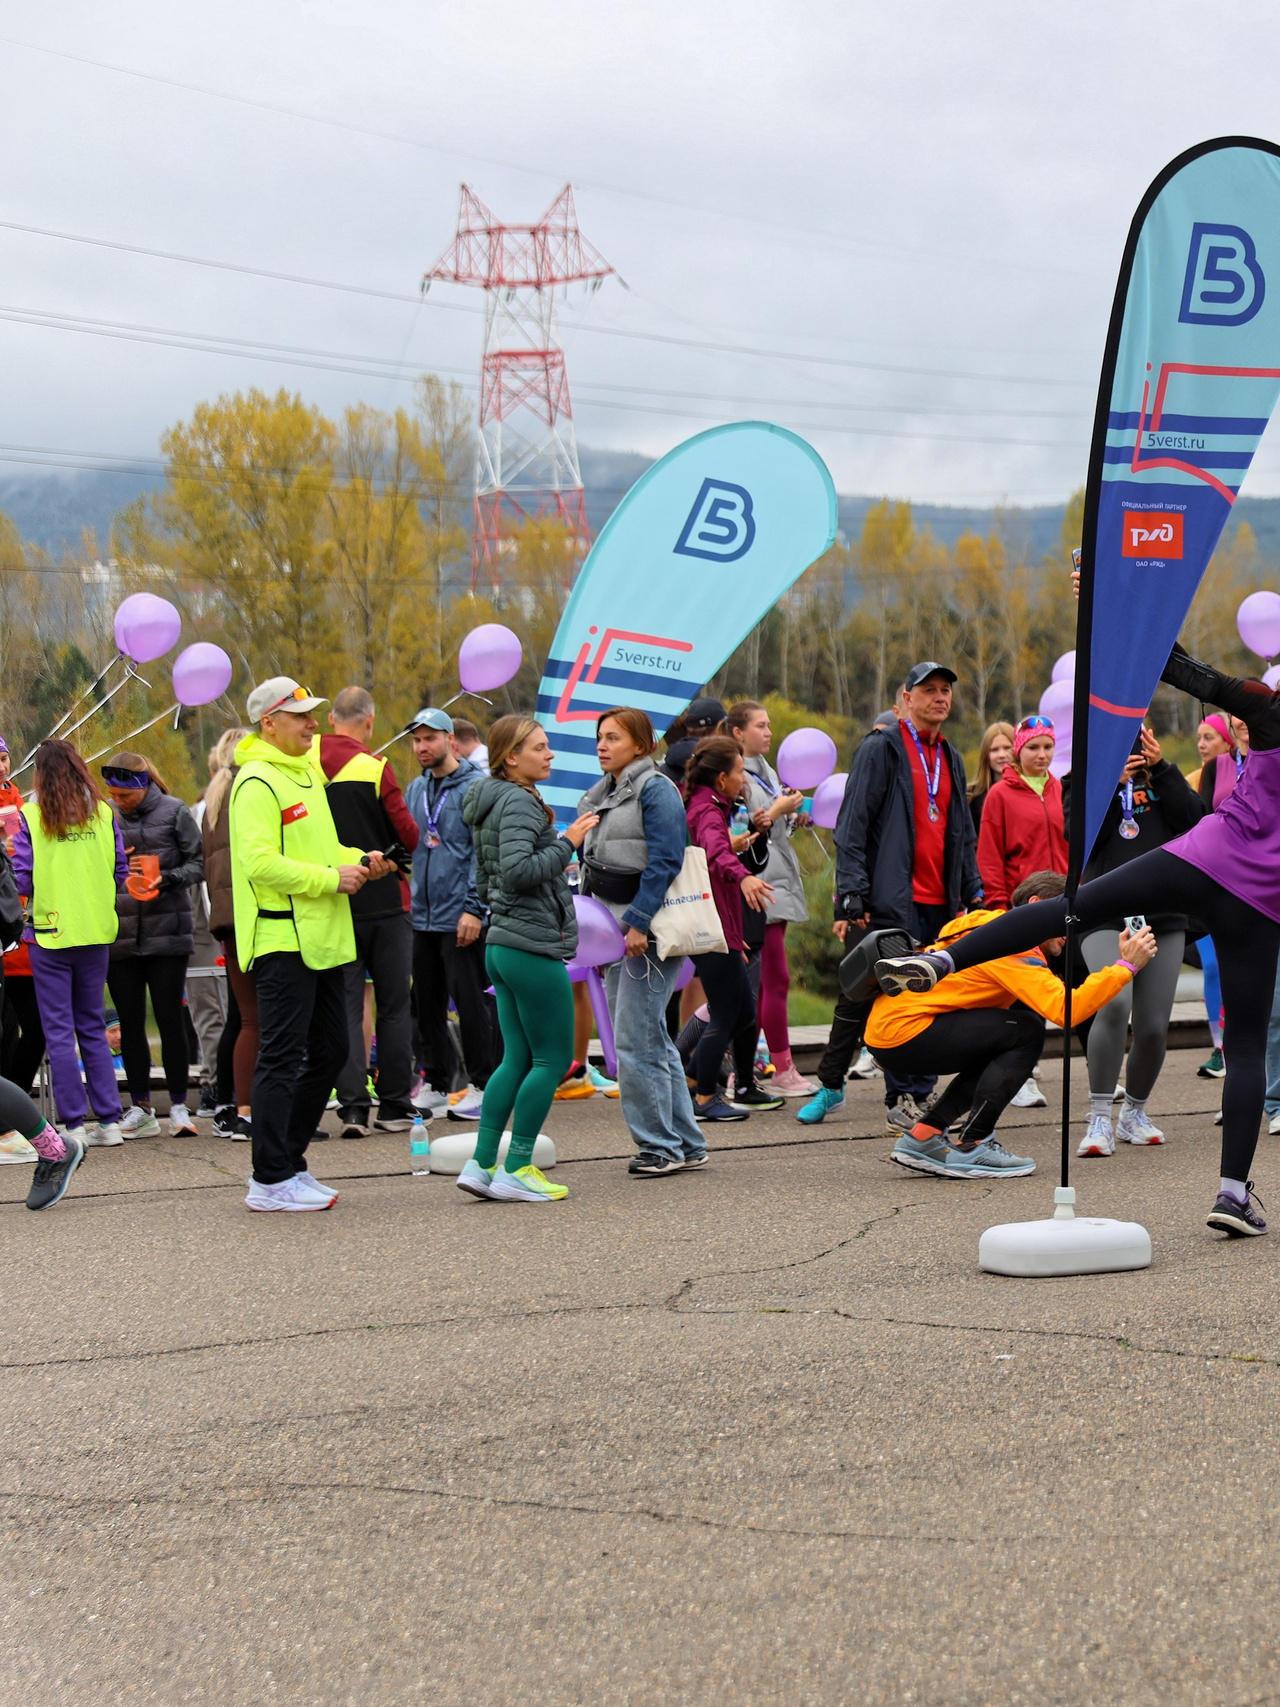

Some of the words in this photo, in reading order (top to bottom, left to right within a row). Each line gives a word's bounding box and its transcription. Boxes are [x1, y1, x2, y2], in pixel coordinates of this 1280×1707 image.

[1147, 433, 1205, 449] 5verst.ru
[1121, 501, 1164, 509] ОФИЦИАЛЬНЫЙ
[1164, 503, 1188, 511] ПАРТНЕР
[1135, 560, 1149, 568] ОАО
[614, 647, 682, 672] 5verst.ru
